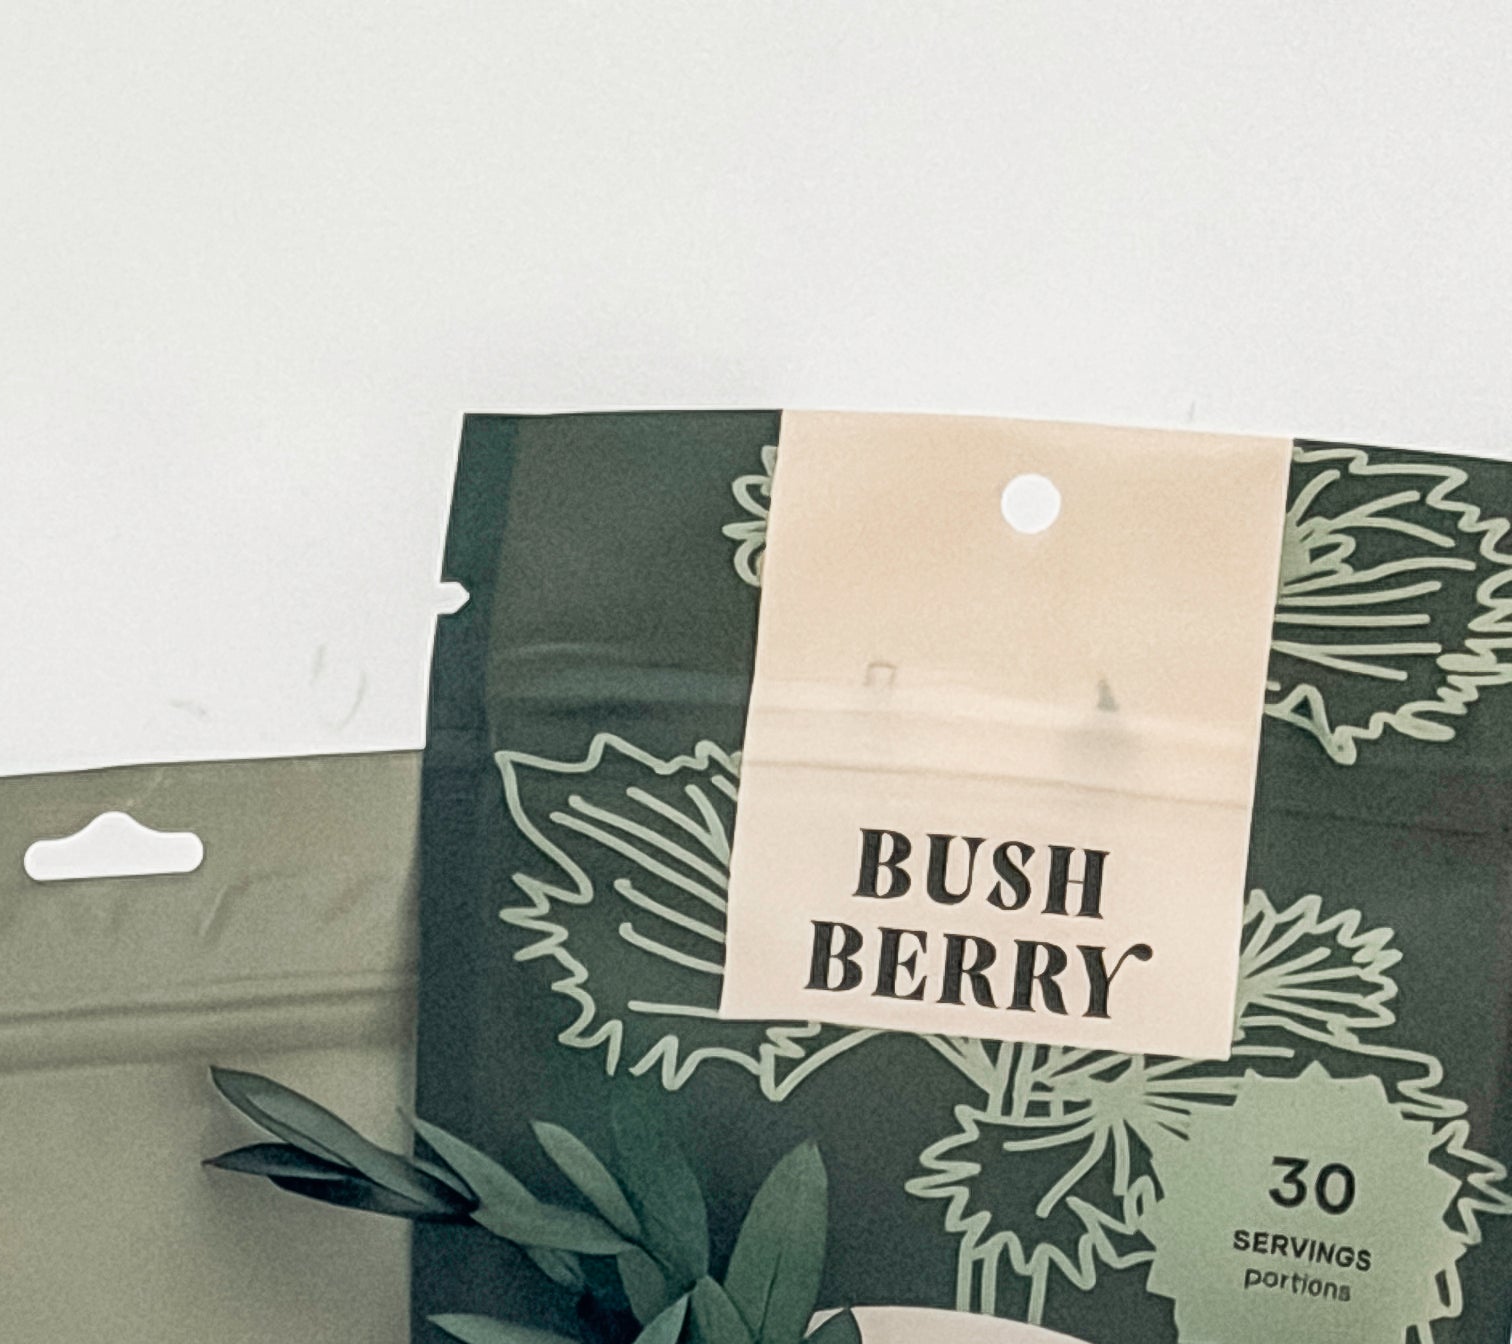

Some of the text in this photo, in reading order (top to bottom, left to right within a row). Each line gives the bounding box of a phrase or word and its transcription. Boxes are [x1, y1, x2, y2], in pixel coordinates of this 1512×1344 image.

[852, 827, 1110, 920] BUSH
[803, 921, 1152, 1019] BERRY
[1269, 1156, 1356, 1215] 30
[1233, 1229, 1372, 1273] SERVINGS
[1244, 1266, 1351, 1304] portions
